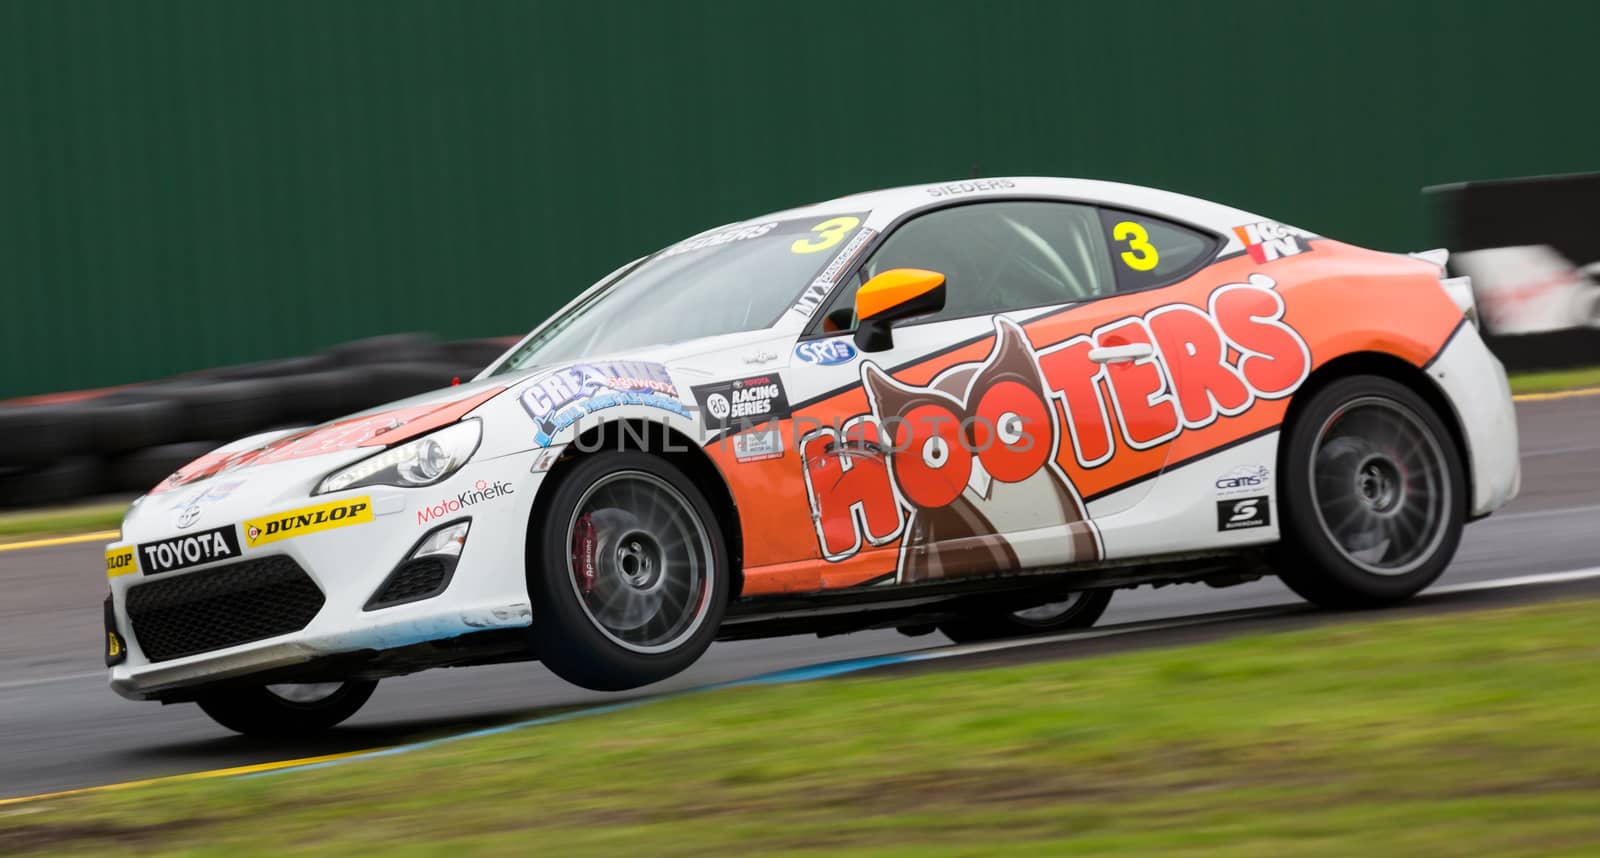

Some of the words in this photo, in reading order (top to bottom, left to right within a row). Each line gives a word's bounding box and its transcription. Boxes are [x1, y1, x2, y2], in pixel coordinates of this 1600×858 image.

[926, 179, 1016, 198] SIEDERS
[791, 216, 860, 254] 3
[1113, 221, 1159, 271] 3
[730, 399, 772, 418] SERIES
[731, 384, 779, 404] RACING
[799, 281, 1312, 563] HOOTERS
[265, 503, 367, 536] DUNLOP
[417, 480, 514, 525] MotoKinetic
[144, 531, 231, 571] TOYOTA
